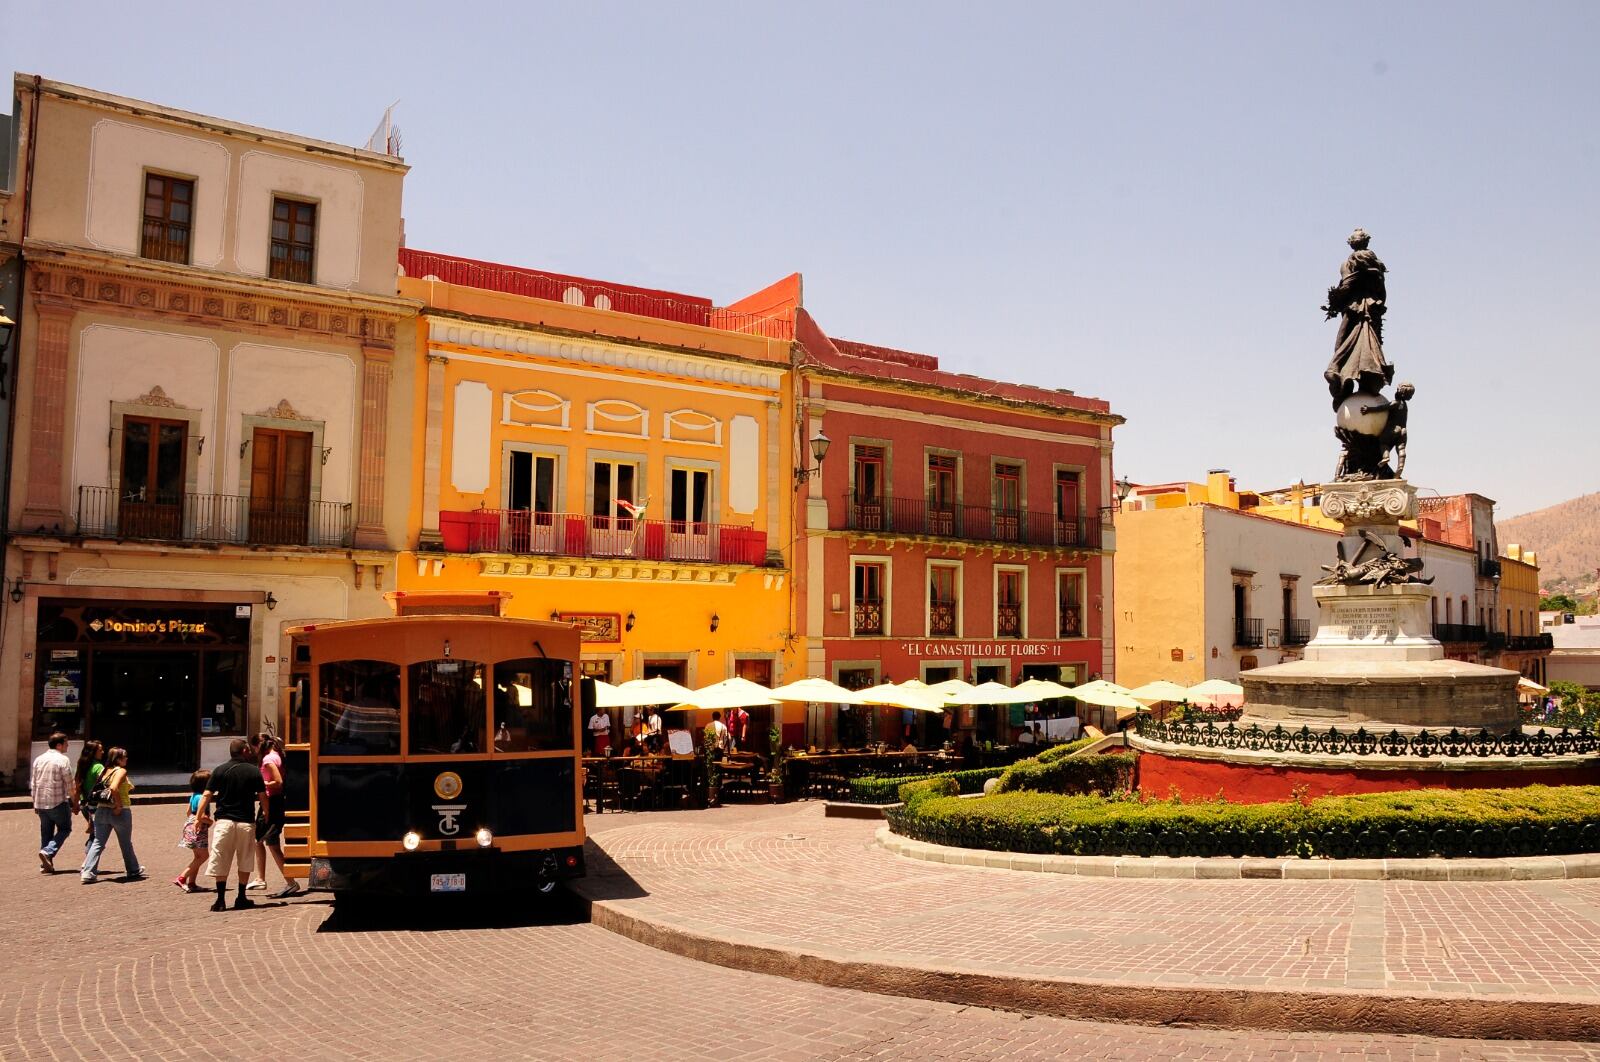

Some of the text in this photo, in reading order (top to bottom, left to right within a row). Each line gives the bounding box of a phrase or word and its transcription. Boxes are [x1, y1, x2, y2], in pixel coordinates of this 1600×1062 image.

[104, 619, 204, 632] Domino's Pizza
[925, 643, 992, 656] CANASTILLO
[995, 643, 1007, 656] DE
